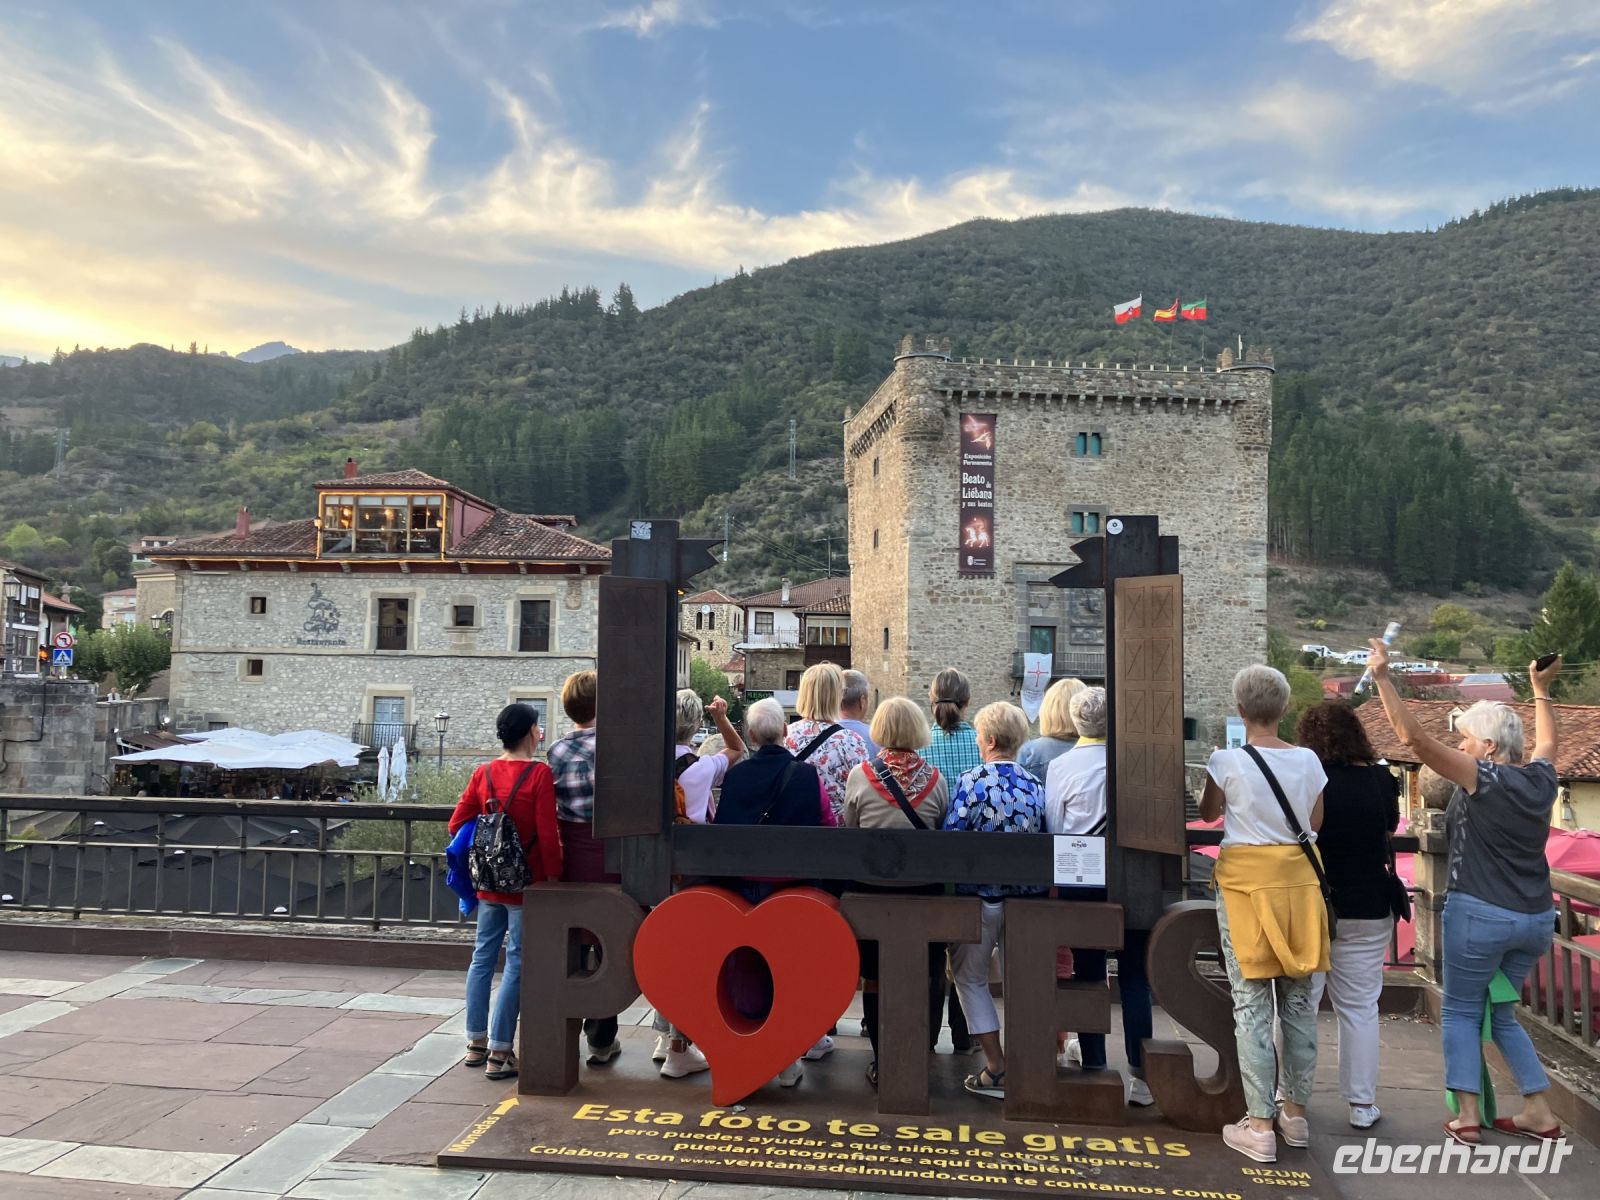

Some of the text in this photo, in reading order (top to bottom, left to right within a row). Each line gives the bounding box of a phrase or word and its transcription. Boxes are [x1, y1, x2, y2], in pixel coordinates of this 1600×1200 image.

[962, 472, 985, 484] Beato
[962, 487, 992, 499] Liébana
[447, 1114, 501, 1153] Monedas
[572, 1103, 1192, 1158] Esta foto te sale gratis
[607, 1126, 1161, 1171] pero puedes ayudar a que niños de otros lugares,
[672, 1141, 760, 1155] puedan
[765, 1146, 913, 1164] fotografiarse
[918, 1157, 971, 1169] aquí
[528, 1145, 1242, 1200] Colabora con www.ventanasdelmundo.com te contamos como
[1241, 1167, 1311, 1180] BIZUM
